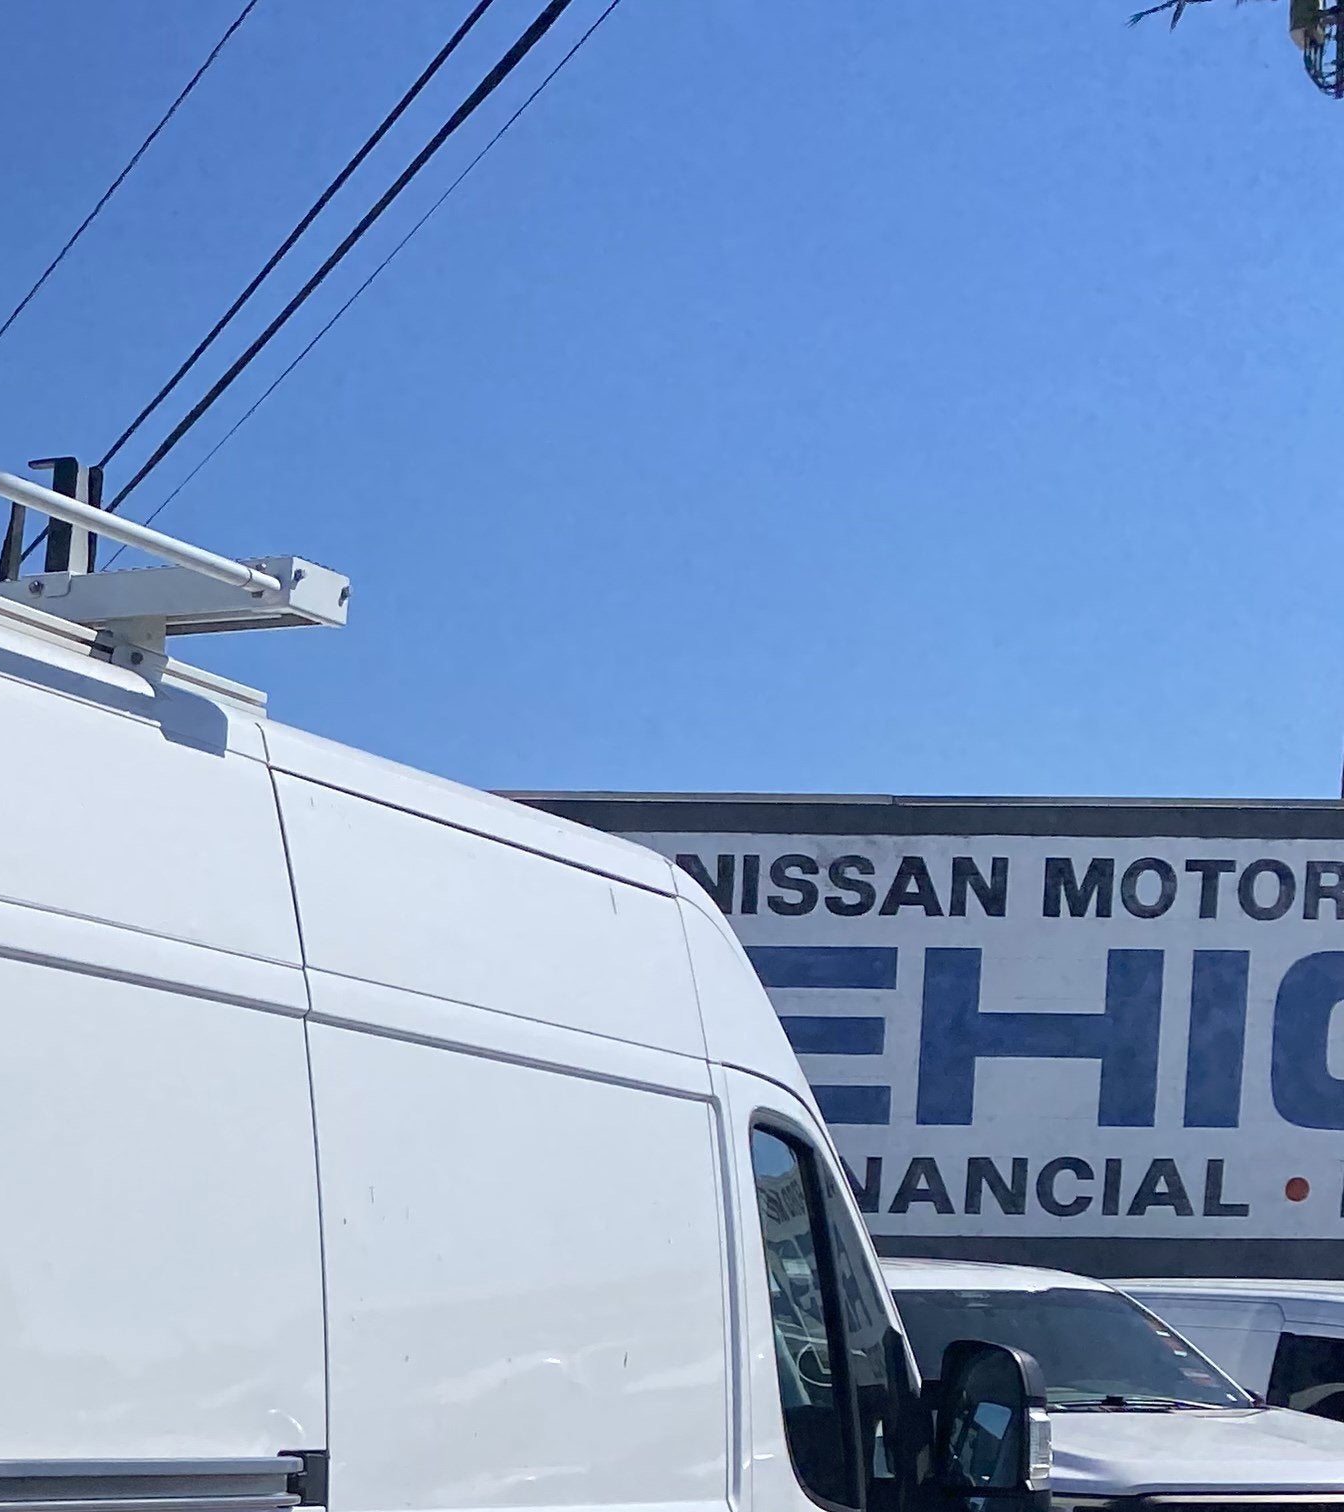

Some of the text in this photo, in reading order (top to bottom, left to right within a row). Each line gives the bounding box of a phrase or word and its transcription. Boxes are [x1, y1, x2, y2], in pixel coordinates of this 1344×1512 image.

[675, 852, 1344, 921] NISSAN MOTOR
[838, 1155, 1251, 1218] NANCIAL
